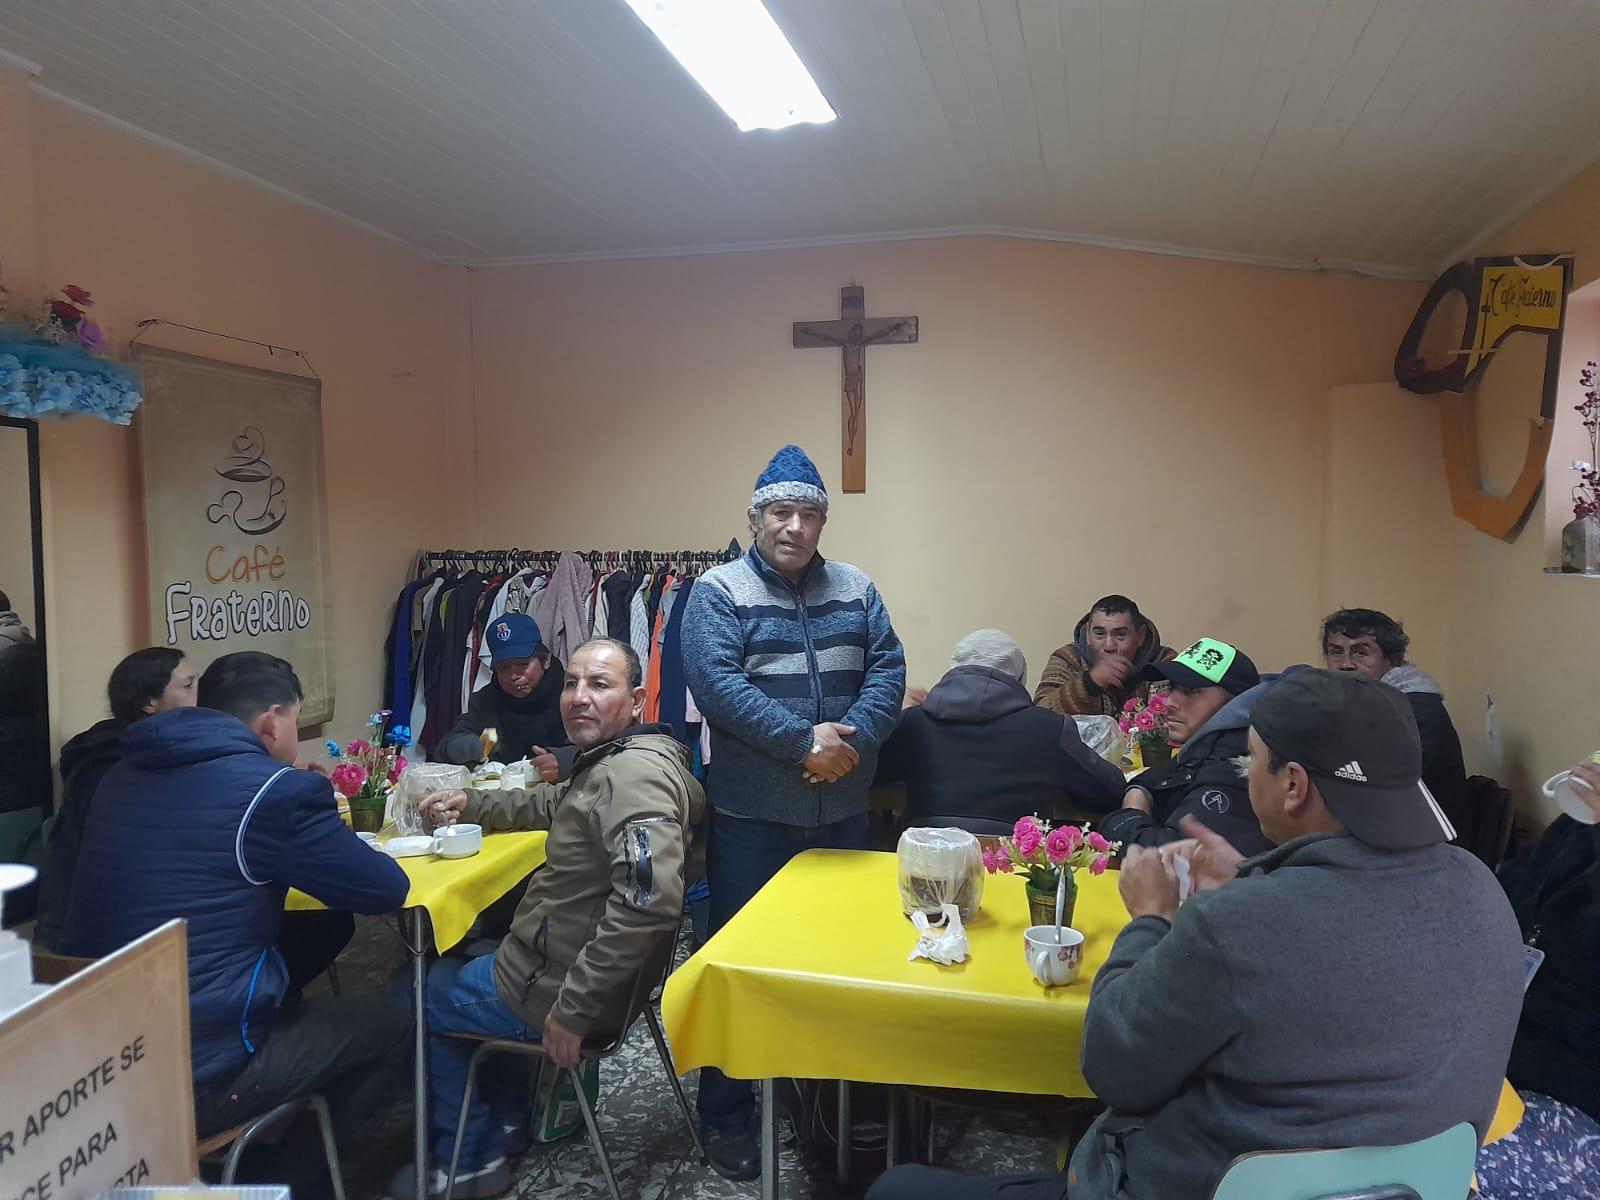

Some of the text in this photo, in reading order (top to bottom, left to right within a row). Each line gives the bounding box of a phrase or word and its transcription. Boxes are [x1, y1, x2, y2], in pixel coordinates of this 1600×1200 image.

[206, 545, 286, 584] Café
[1335, 770, 1368, 782] adidas
[23, 1056, 115, 1147] APORTE
[120, 1036, 146, 1071] SE
[59, 1122, 118, 1188] PARA
